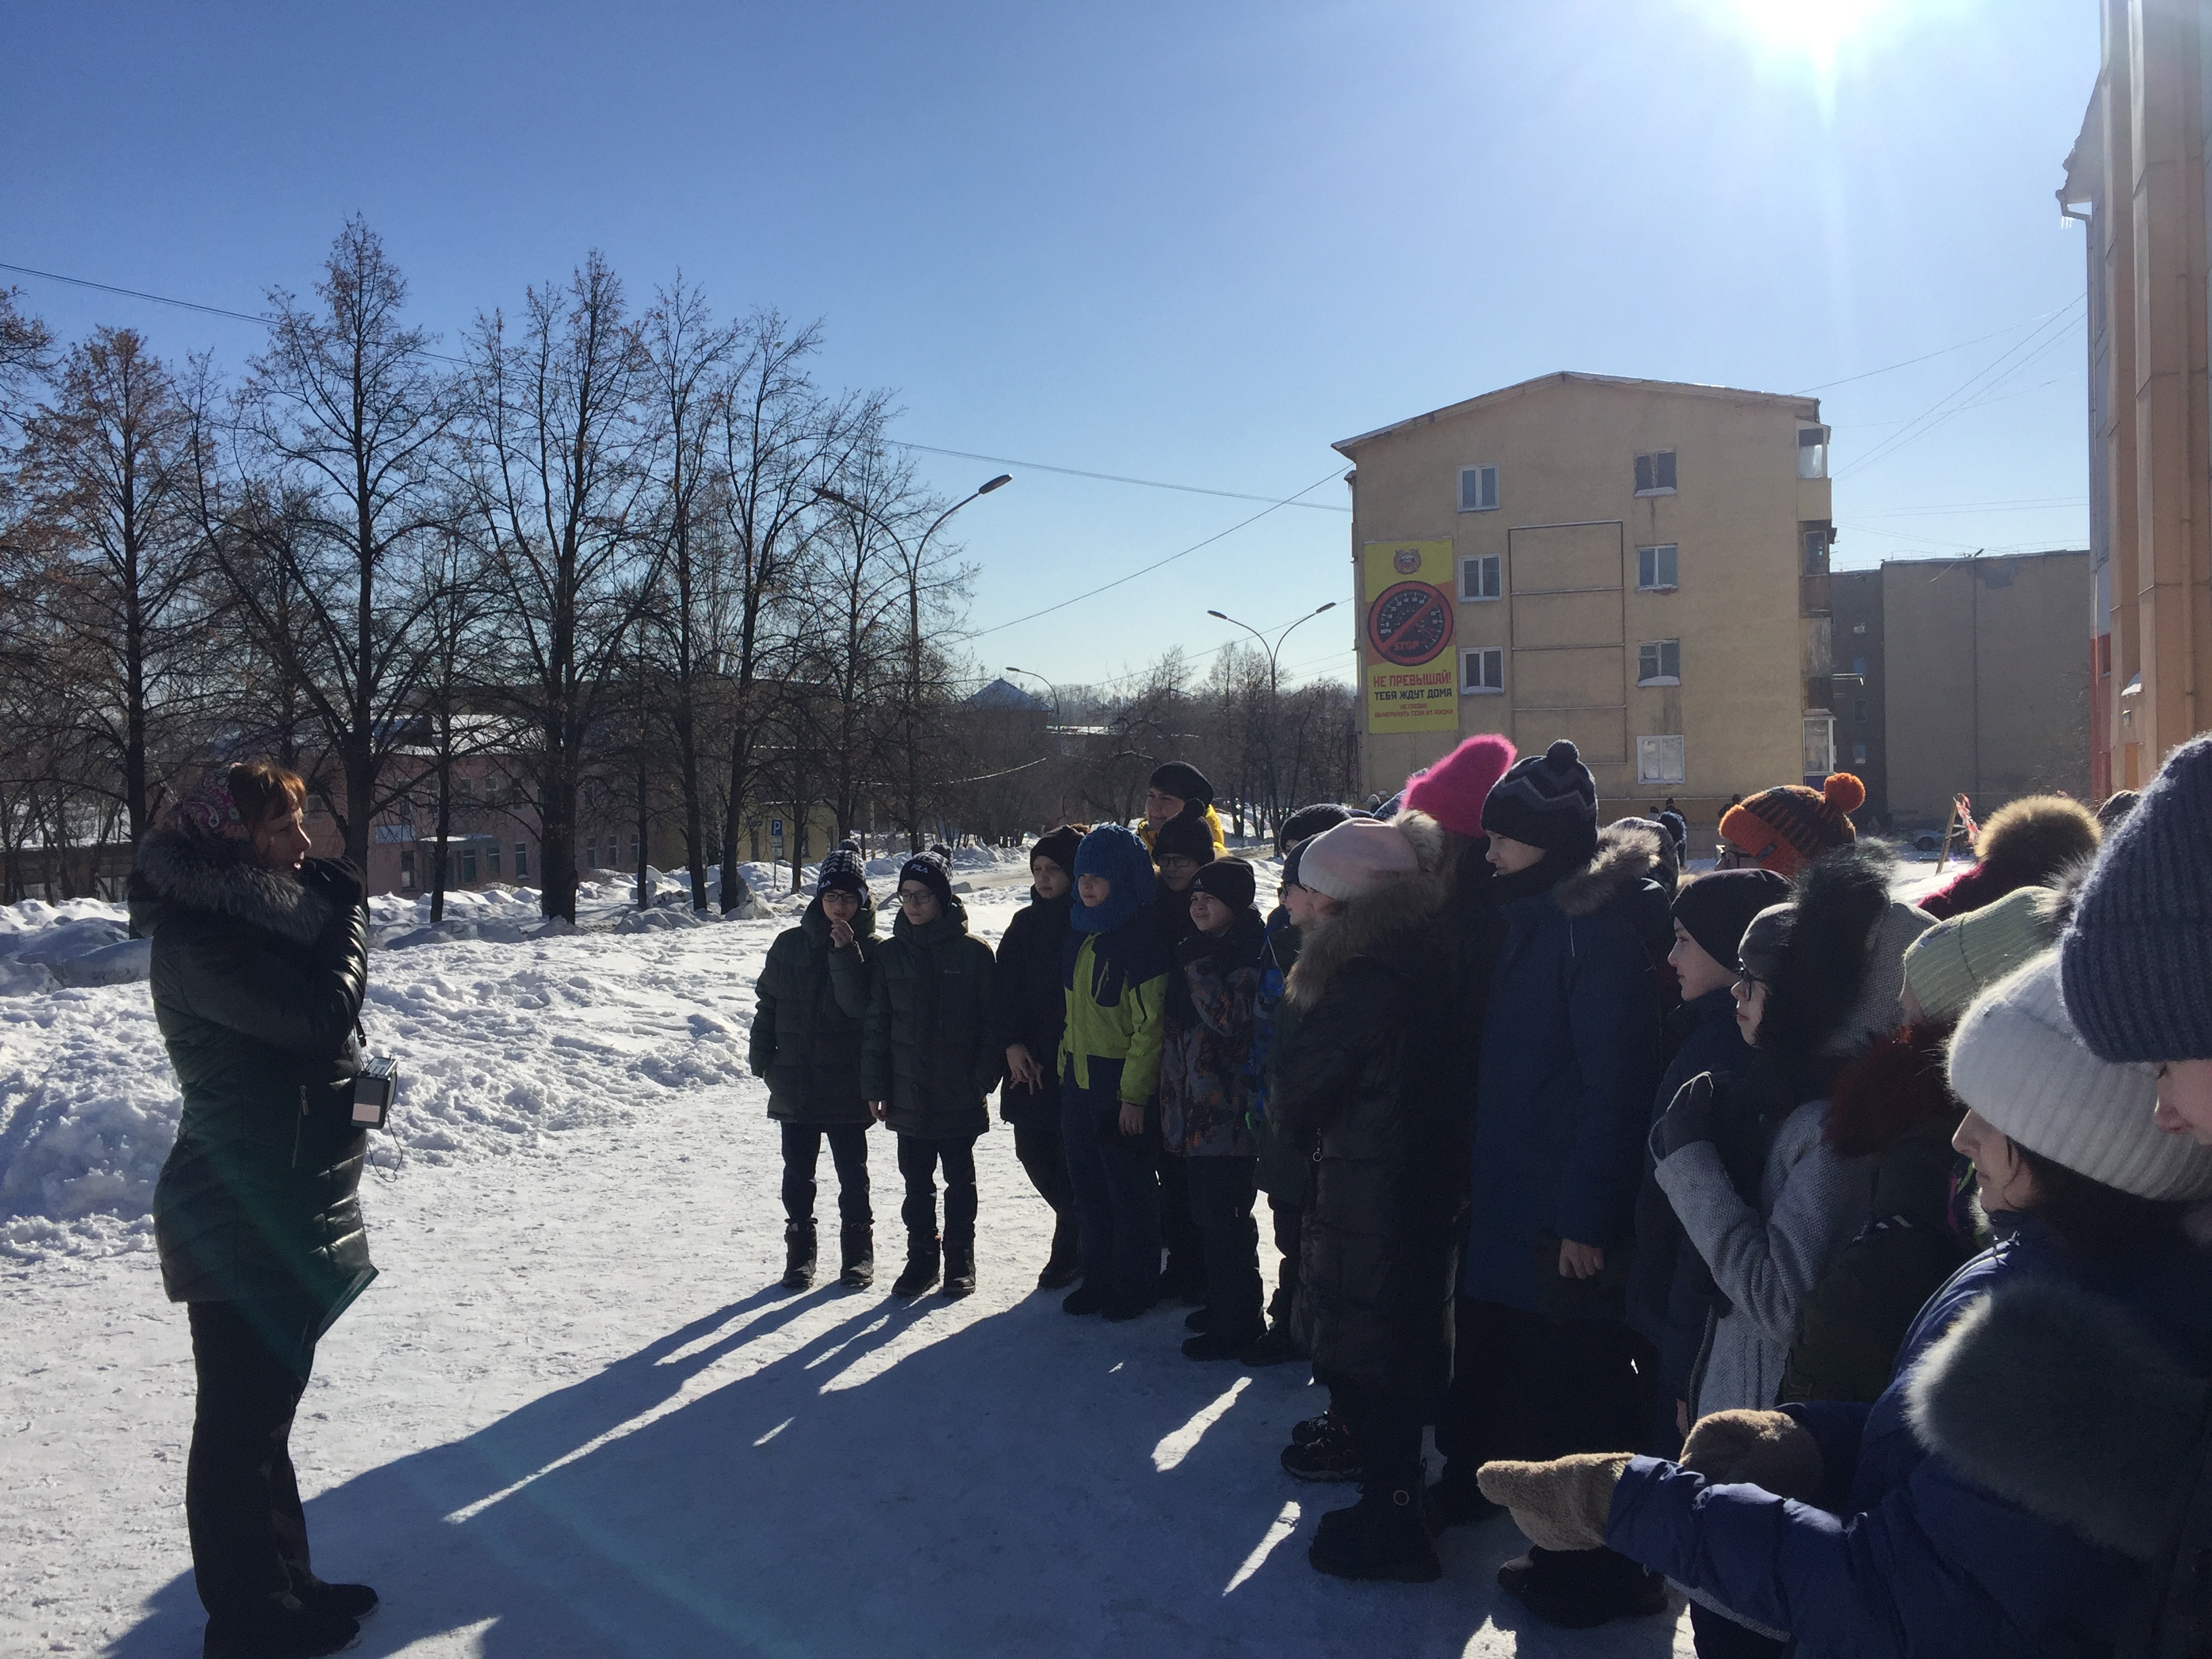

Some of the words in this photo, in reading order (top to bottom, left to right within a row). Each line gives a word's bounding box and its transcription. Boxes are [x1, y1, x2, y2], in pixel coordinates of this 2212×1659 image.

[1395, 641, 1419, 651] STOP
[1374, 676, 1387, 687] НЕ
[1389, 670, 1451, 687] ПРЕВЫШАЙ!
[1374, 691, 1397, 701] ТЕБЯ
[1399, 689, 1425, 700] ЖДУТ
[1427, 688, 1452, 699] ДОМА
[773, 821, 781, 834] P
[910, 863, 928, 874] FILA
